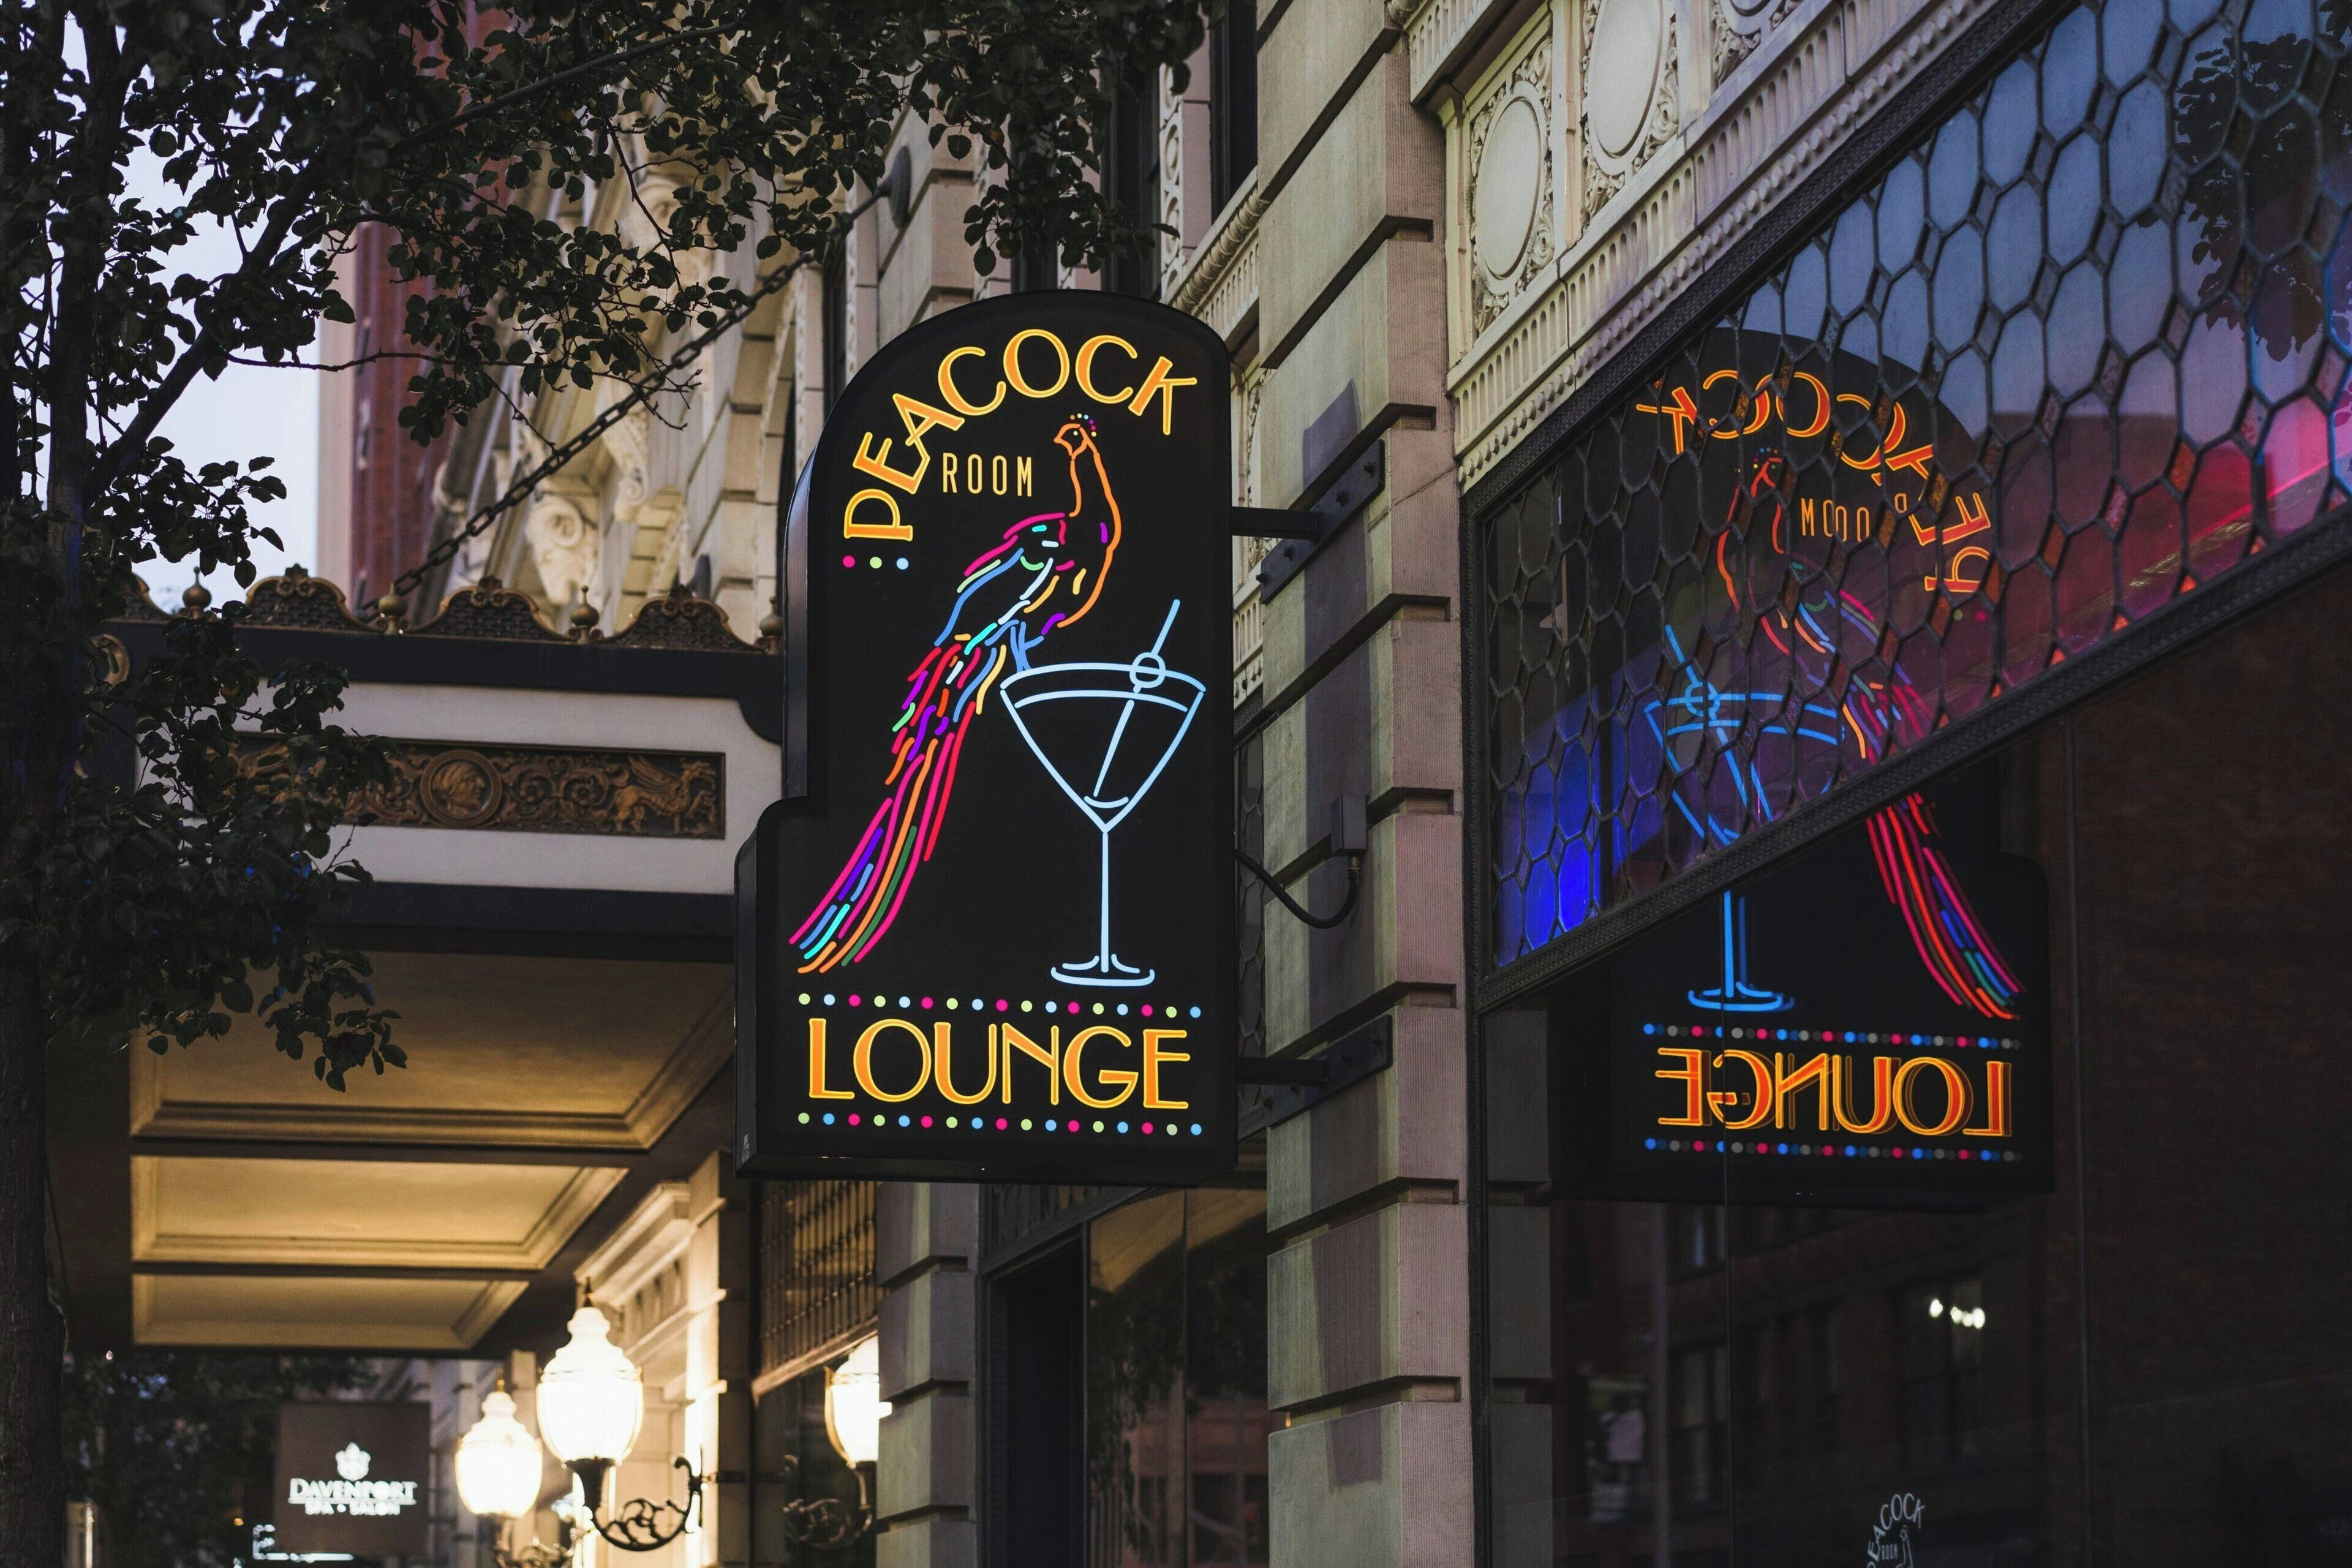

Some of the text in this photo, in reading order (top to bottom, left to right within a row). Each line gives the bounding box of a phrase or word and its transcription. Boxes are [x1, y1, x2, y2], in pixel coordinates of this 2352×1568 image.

[843, 328, 1197, 541] PEACOCK
[942, 452, 1033, 497] ROOM
[809, 1017, 1191, 1110] LOUNGE
[290, 1477, 418, 1500] DAVENPORT
